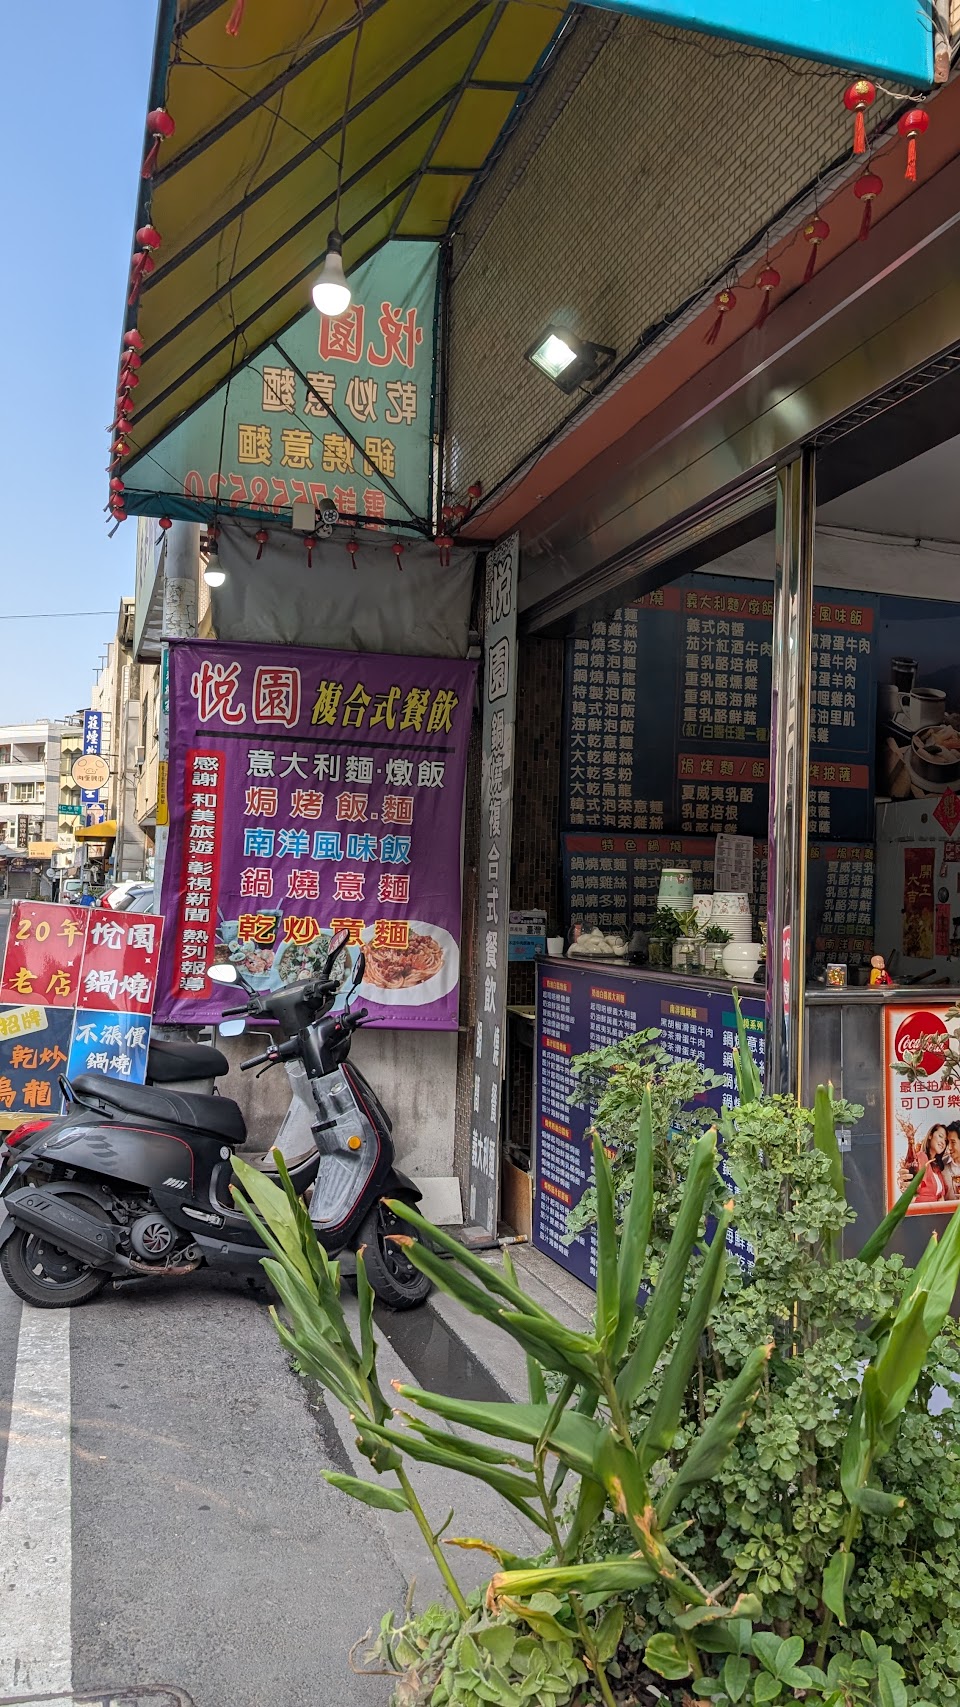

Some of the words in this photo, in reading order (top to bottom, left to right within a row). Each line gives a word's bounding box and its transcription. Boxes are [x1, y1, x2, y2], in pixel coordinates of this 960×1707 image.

[685, 591, 774, 616] 義大利麵/燉飯
[812, 604, 863, 626] 風味飯
[686, 617, 745, 637] 義式肉醬
[574, 636, 638, 654] 鍋燒冬粉
[686, 634, 773, 657] 茄汁紅酒牛肉
[573, 652, 637, 670] 鍋燒泡麵
[685, 653, 759, 674] 重乳酪培根
[684, 670, 759, 691] 重乳酪燻雞
[571, 684, 636, 702] 特製泡飯
[683, 688, 758, 709] 重乳酪海鮮
[310, 679, 459, 736] 複合式餐飲
[571, 700, 636, 718] 韓式泡飯
[683, 706, 757, 726] 重乳酪鮮蔬
[570, 716, 635, 734] 海鮮泡飯
[570, 732, 634, 750] 大乾意麵
[570, 748, 633, 766] 大乾雞絲
[680, 756, 766, 778] 焗烤麵/飯
[191, 755, 220, 788] 感謝
[570, 764, 633, 782] 大乾冬粉
[681, 784, 754, 803] 夏威夷乳酪
[569, 796, 664, 815] 韓式泡菜意麵
[681, 802, 739, 822] 乳酪培根
[242, 827, 412, 865] 南洋風味飯
[600, 837, 684, 853] 特色鍋燒
[570, 856, 628, 872] 鍋燒意麵
[240, 867, 411, 905] 鍋燒意麵
[570, 874, 628, 890] 鍋燒雞絲
[570, 893, 627, 908] 鍋燒冬粉
[237, 913, 411, 951] 乾炒意麵
[824, 938, 874, 951] 南洋風
[179, 928, 209, 992] 熱列報導
[8, 966, 72, 998] 老店
[83, 968, 151, 1004] 鍋燒
[0, 1009, 43, 1037] 招牌
[75, 1022, 148, 1050] 不漲價
[9, 1044, 68, 1072] 乾炒
[85, 1051, 133, 1076] 鍋燒
